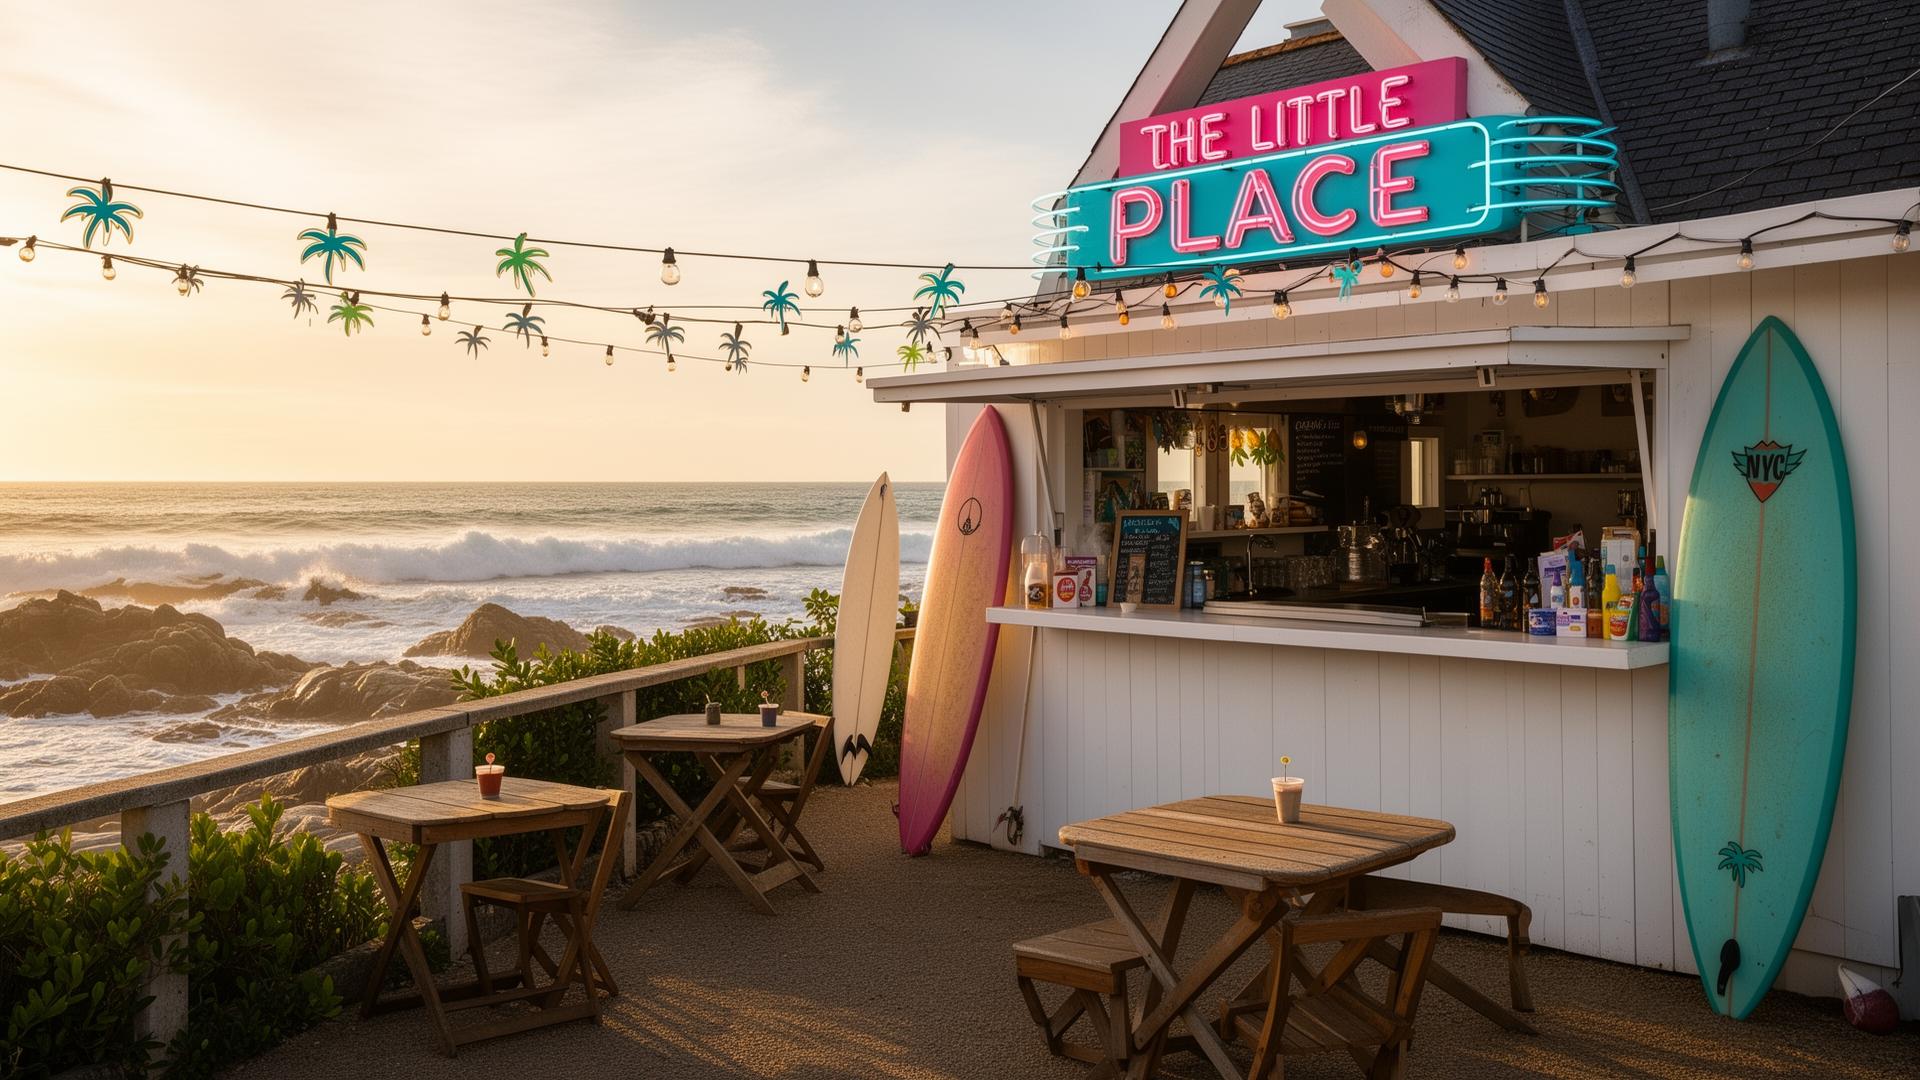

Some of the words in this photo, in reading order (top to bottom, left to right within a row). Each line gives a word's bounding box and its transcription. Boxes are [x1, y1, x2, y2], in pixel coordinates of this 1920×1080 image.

[1140, 112, 1231, 169] THE
[1252, 75, 1414, 150] LITTLE
[1111, 140, 1430, 264] PLACE
[1747, 454, 1785, 481] NYC
